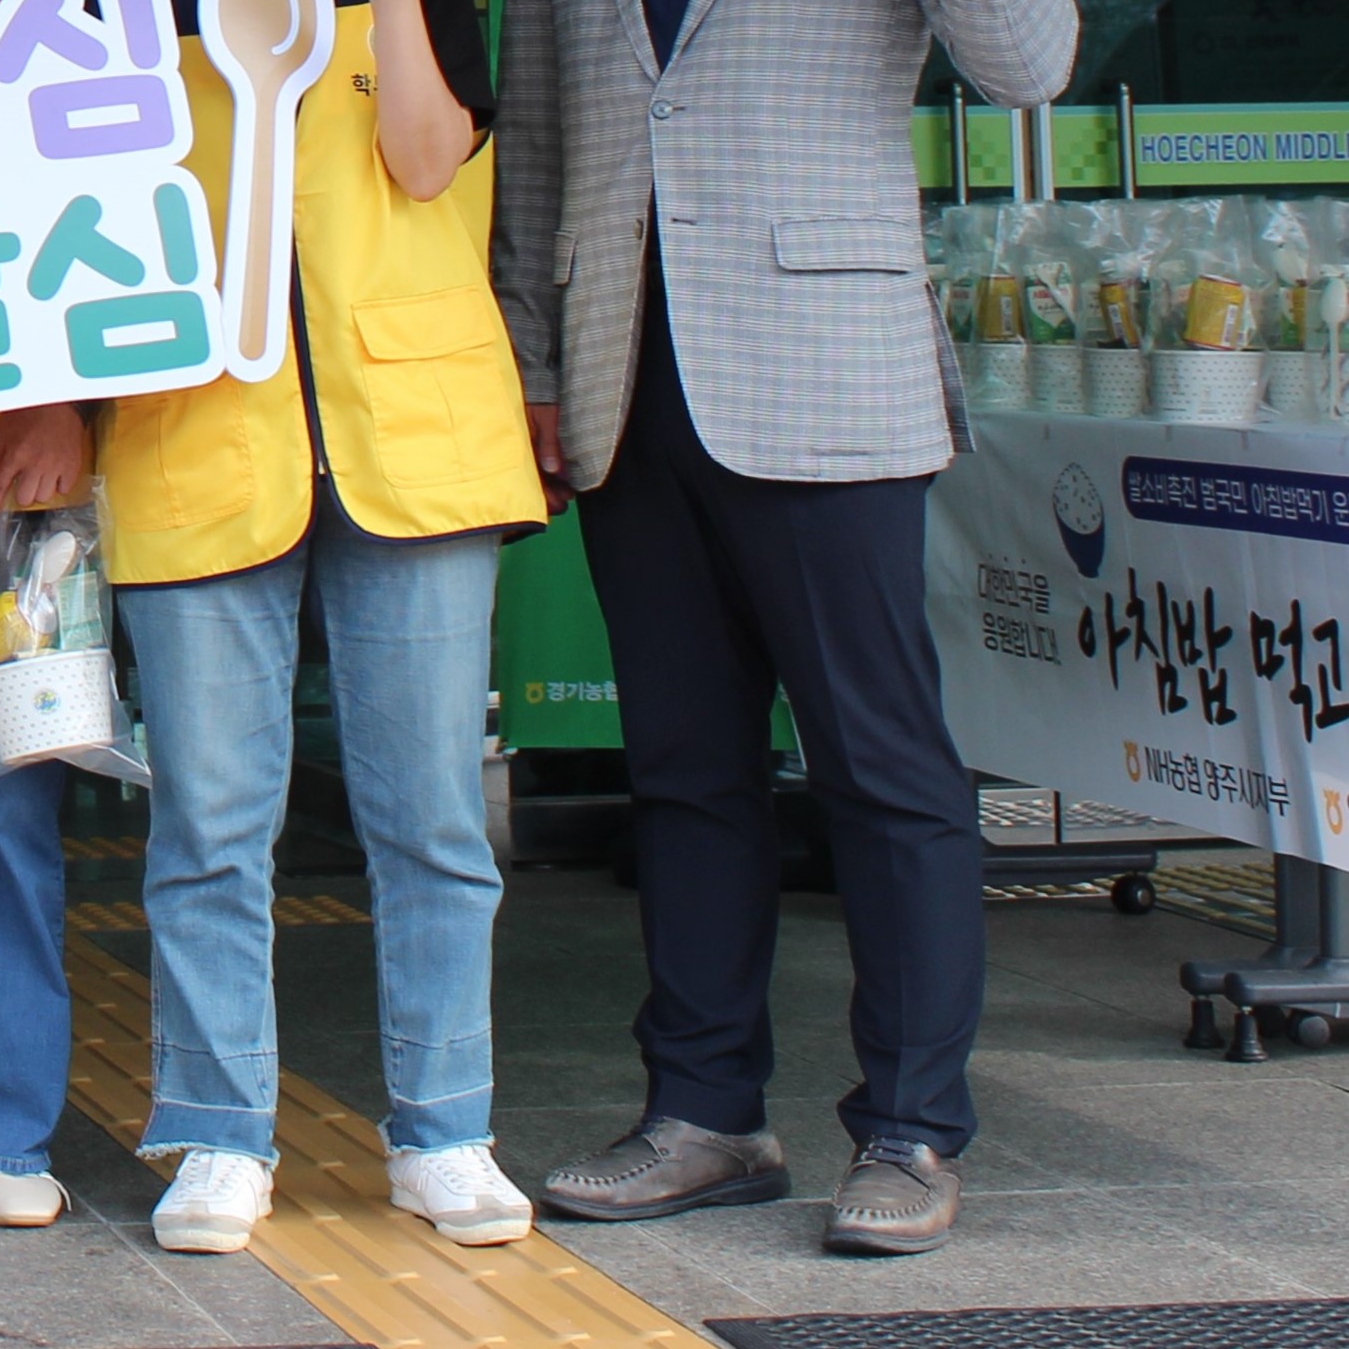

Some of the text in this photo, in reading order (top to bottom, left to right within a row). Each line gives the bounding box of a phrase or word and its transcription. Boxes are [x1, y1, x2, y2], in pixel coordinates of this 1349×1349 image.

[1141, 132, 1349, 163] HOECHEON MIDDL
[1128, 471, 1197, 509] 쌀소비촉진
[1200, 478, 1248, 514] 범국민
[1251, 483, 1330, 525] 아침밥먹기
[978, 563, 1051, 614] 대한민국을
[1077, 566, 1349, 744] 아침밥 먹고
[1145, 746, 1291, 817] NH농협 양주시지부
